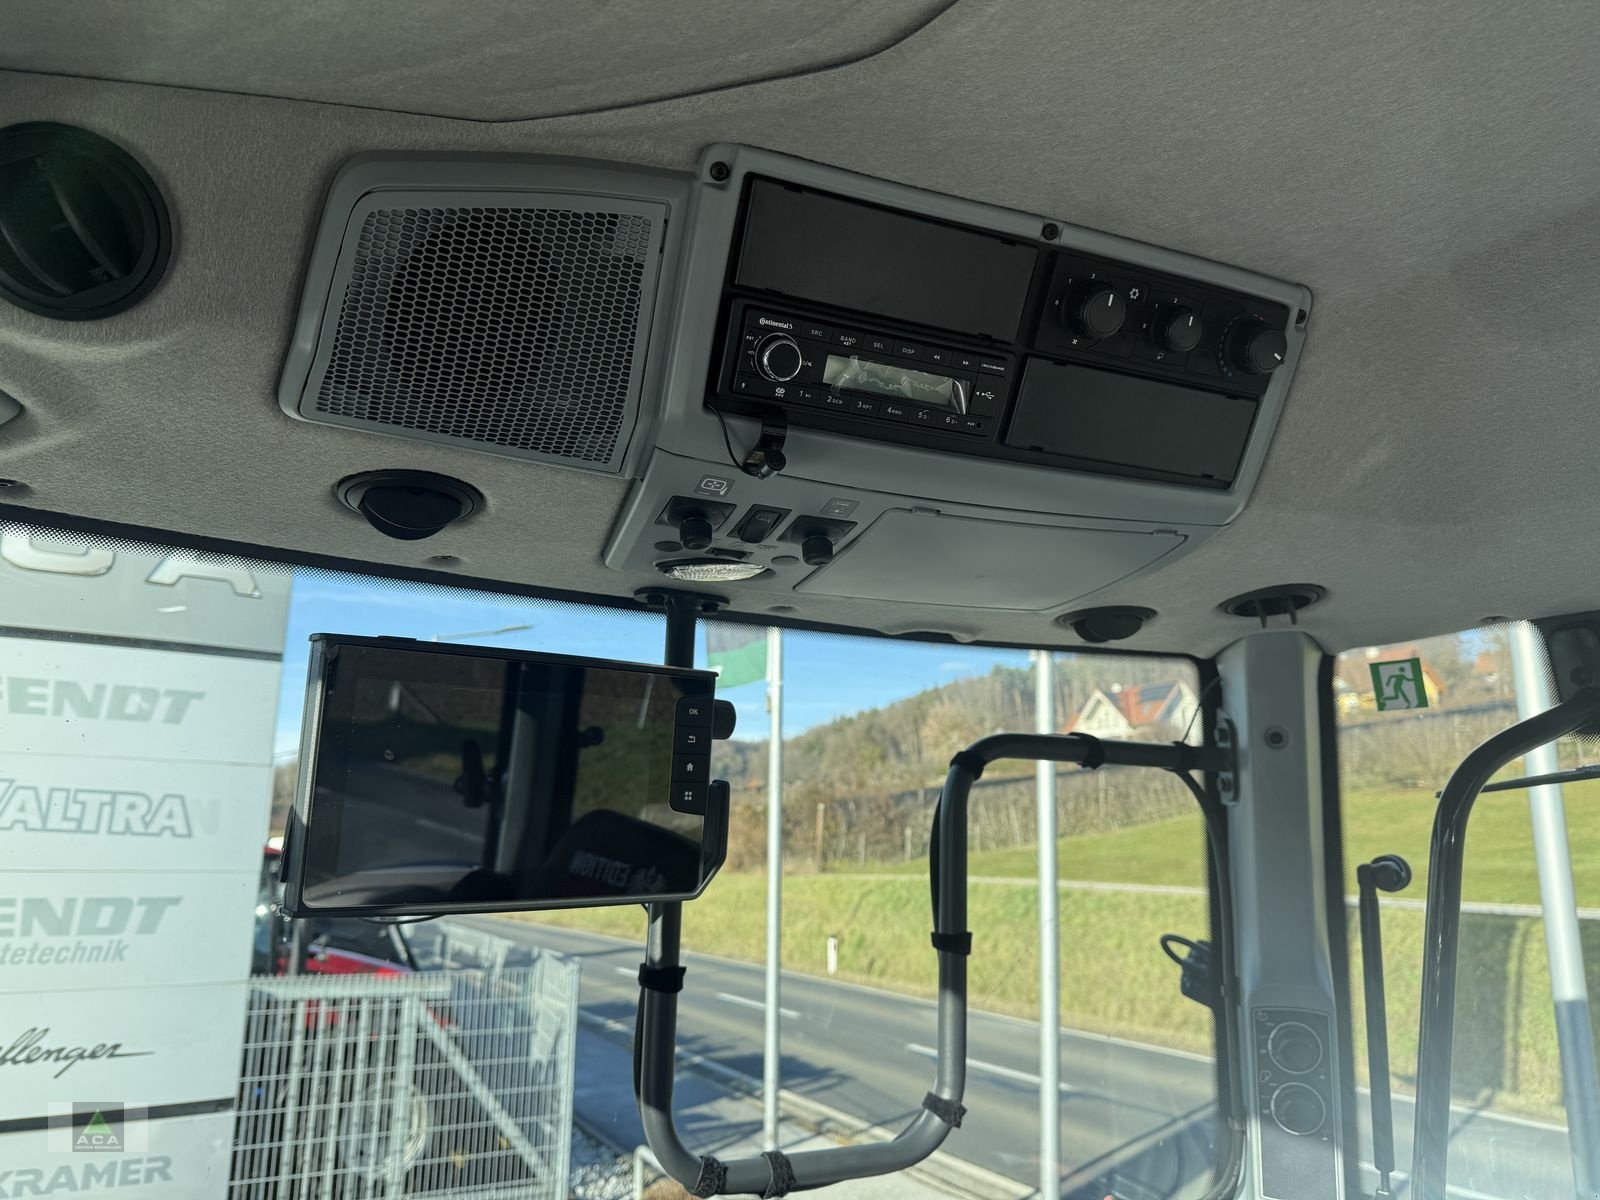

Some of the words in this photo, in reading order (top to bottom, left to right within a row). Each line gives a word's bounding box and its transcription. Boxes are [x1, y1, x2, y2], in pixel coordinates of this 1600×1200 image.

[810, 329, 823, 337] SRC
[840, 335, 856, 344] BAND
[873, 341, 884, 349] SEL
[902, 347, 916, 355] DISP
[827, 395, 832, 403] 2
[857, 401, 862, 409] 3
[0, 676, 207, 725] ENDT
[688, 708, 699, 716] OK
[0, 1026, 155, 1079] llenger
